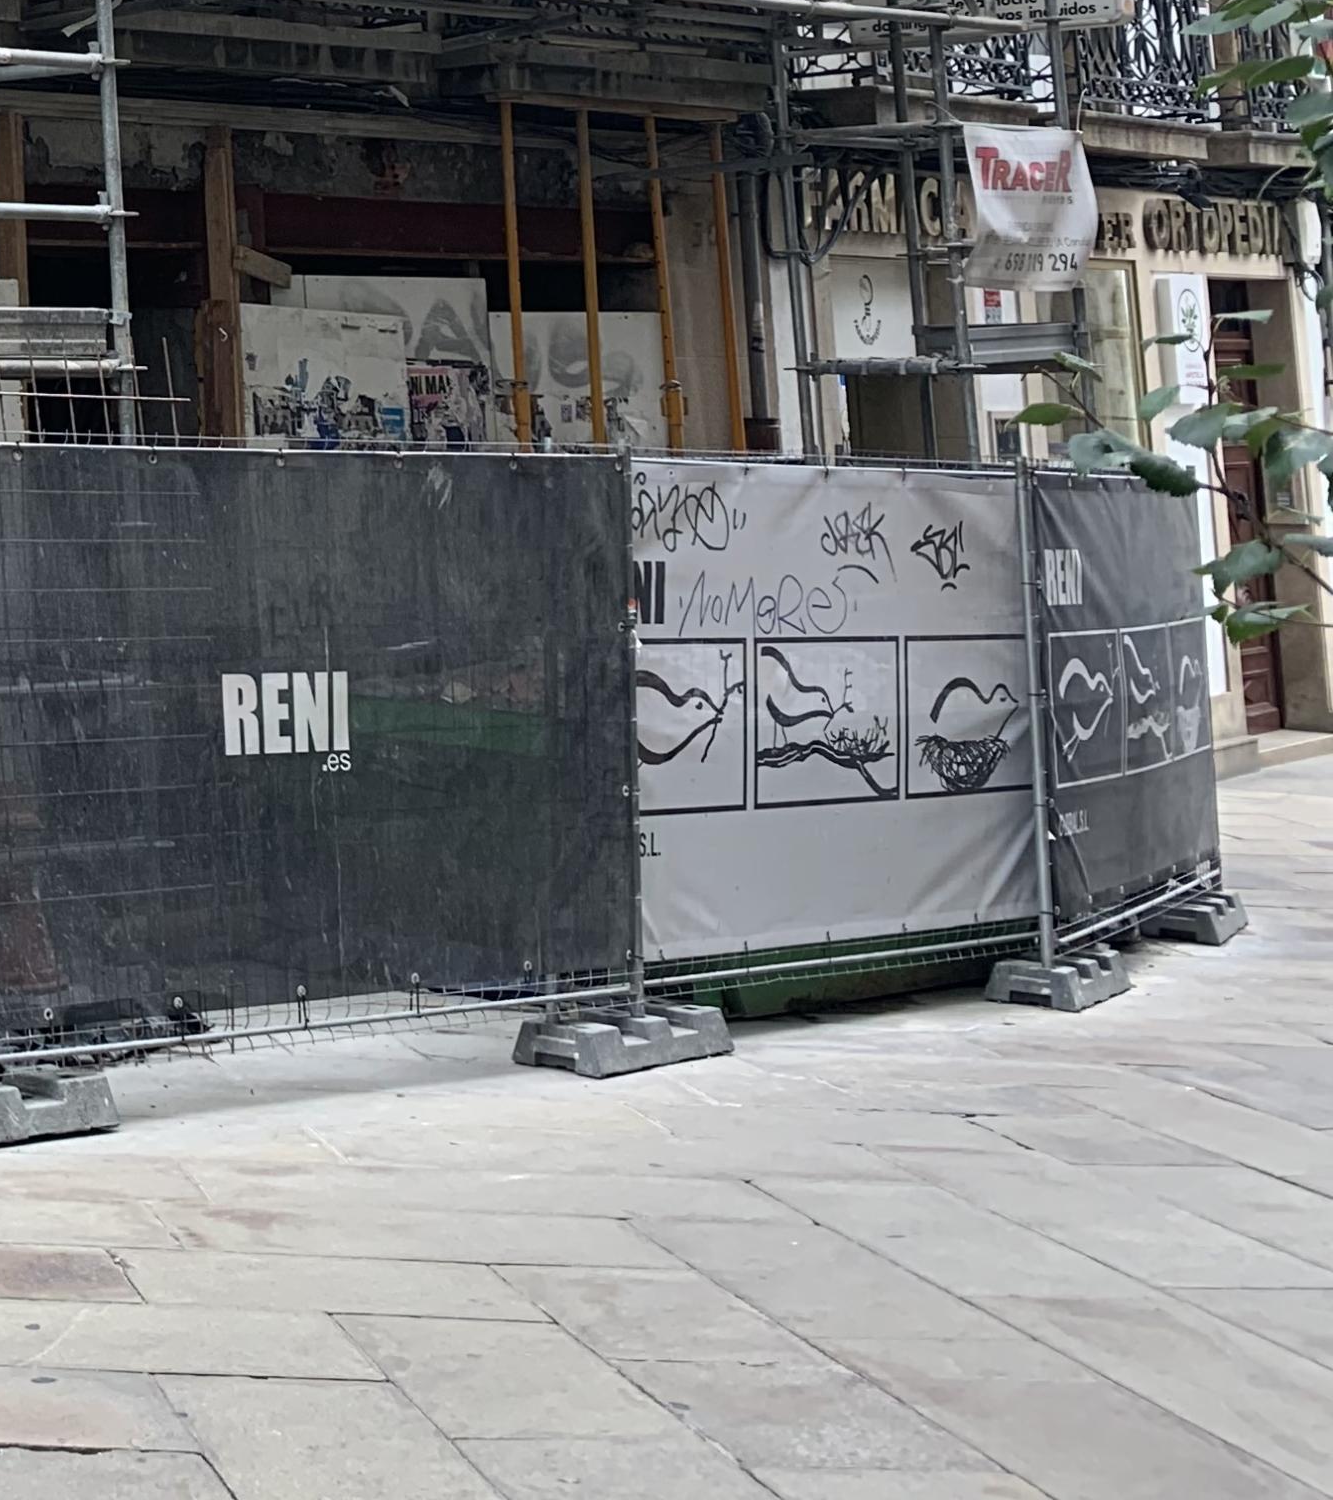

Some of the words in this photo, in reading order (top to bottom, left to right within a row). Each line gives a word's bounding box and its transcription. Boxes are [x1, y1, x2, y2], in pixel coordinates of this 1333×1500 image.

[975, 146, 1073, 193] TRACER
[1048, 253, 1078, 272] 294
[1044, 548, 1083, 606] RENI
[221, 671, 351, 756] RENI
[322, 752, 352, 772] .es
[639, 832, 661, 857] S.L.
